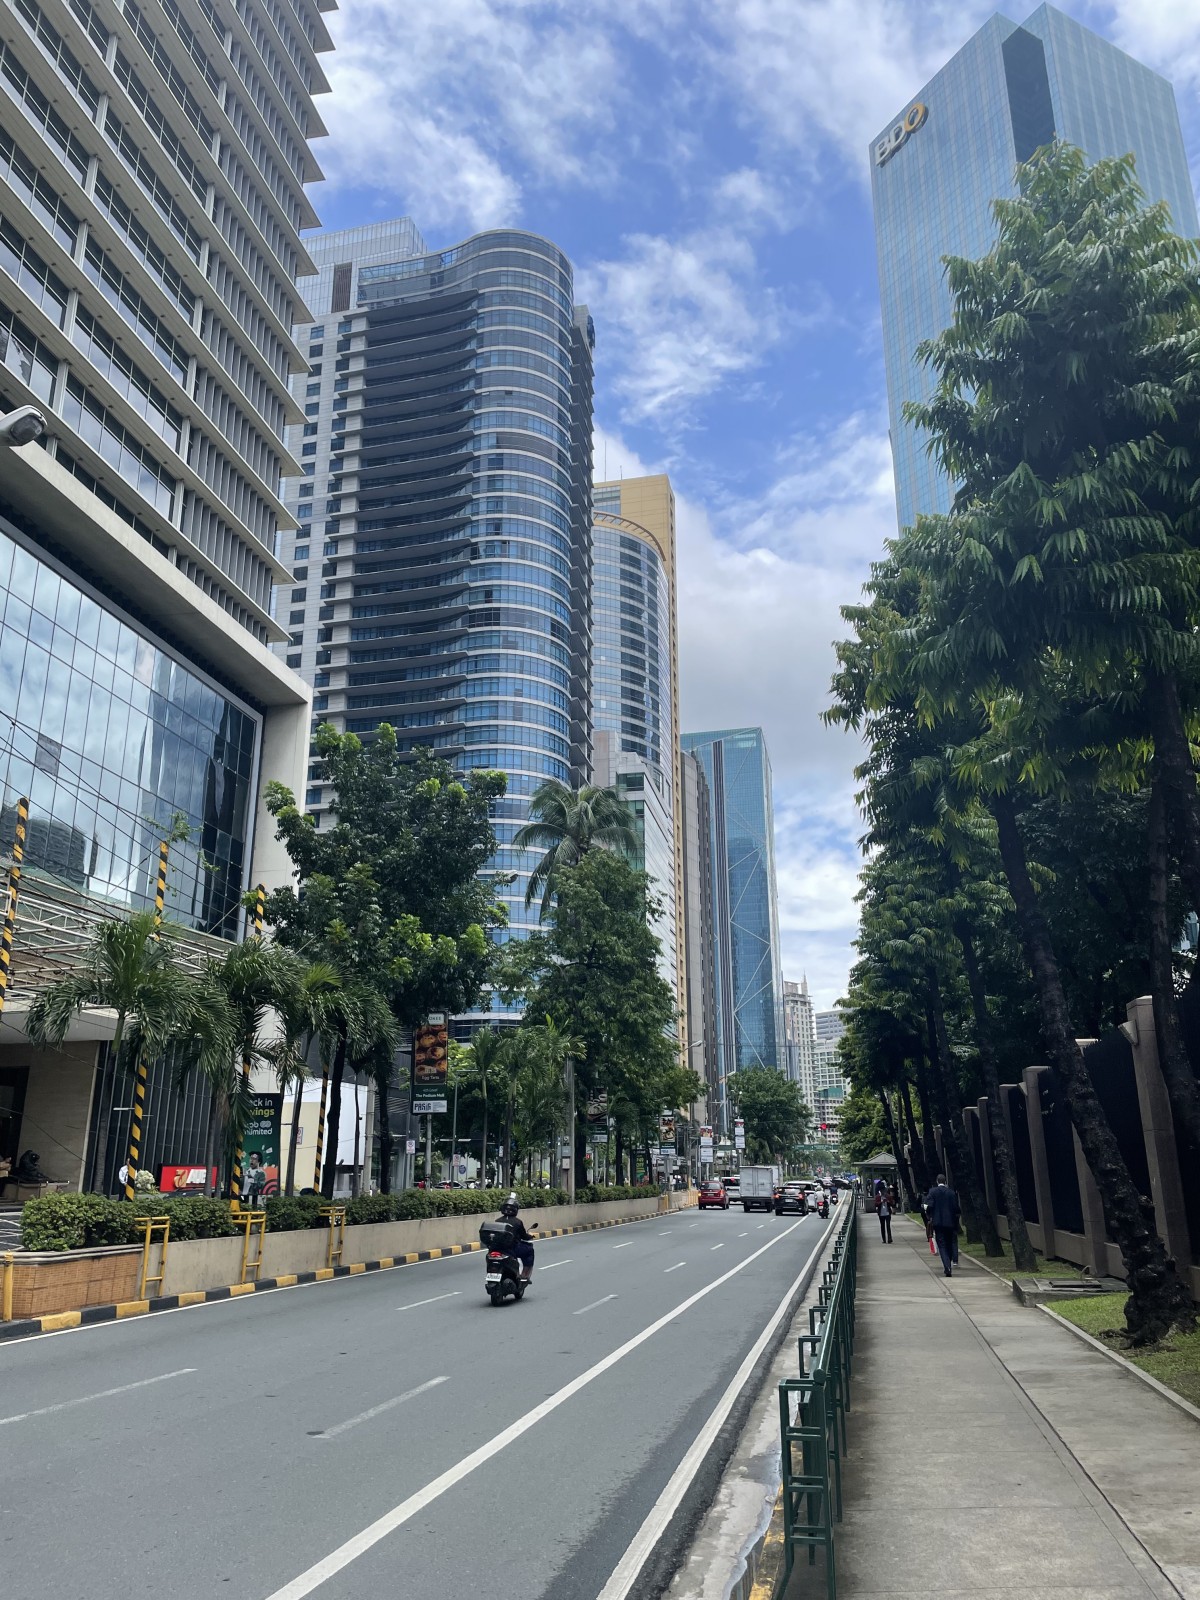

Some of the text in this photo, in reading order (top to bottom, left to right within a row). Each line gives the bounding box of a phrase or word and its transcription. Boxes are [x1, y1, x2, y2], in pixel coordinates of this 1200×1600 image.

[875, 102, 928, 167] BDO
[264, 1098, 273, 1107] in
[250, 1107, 275, 1118] vings
